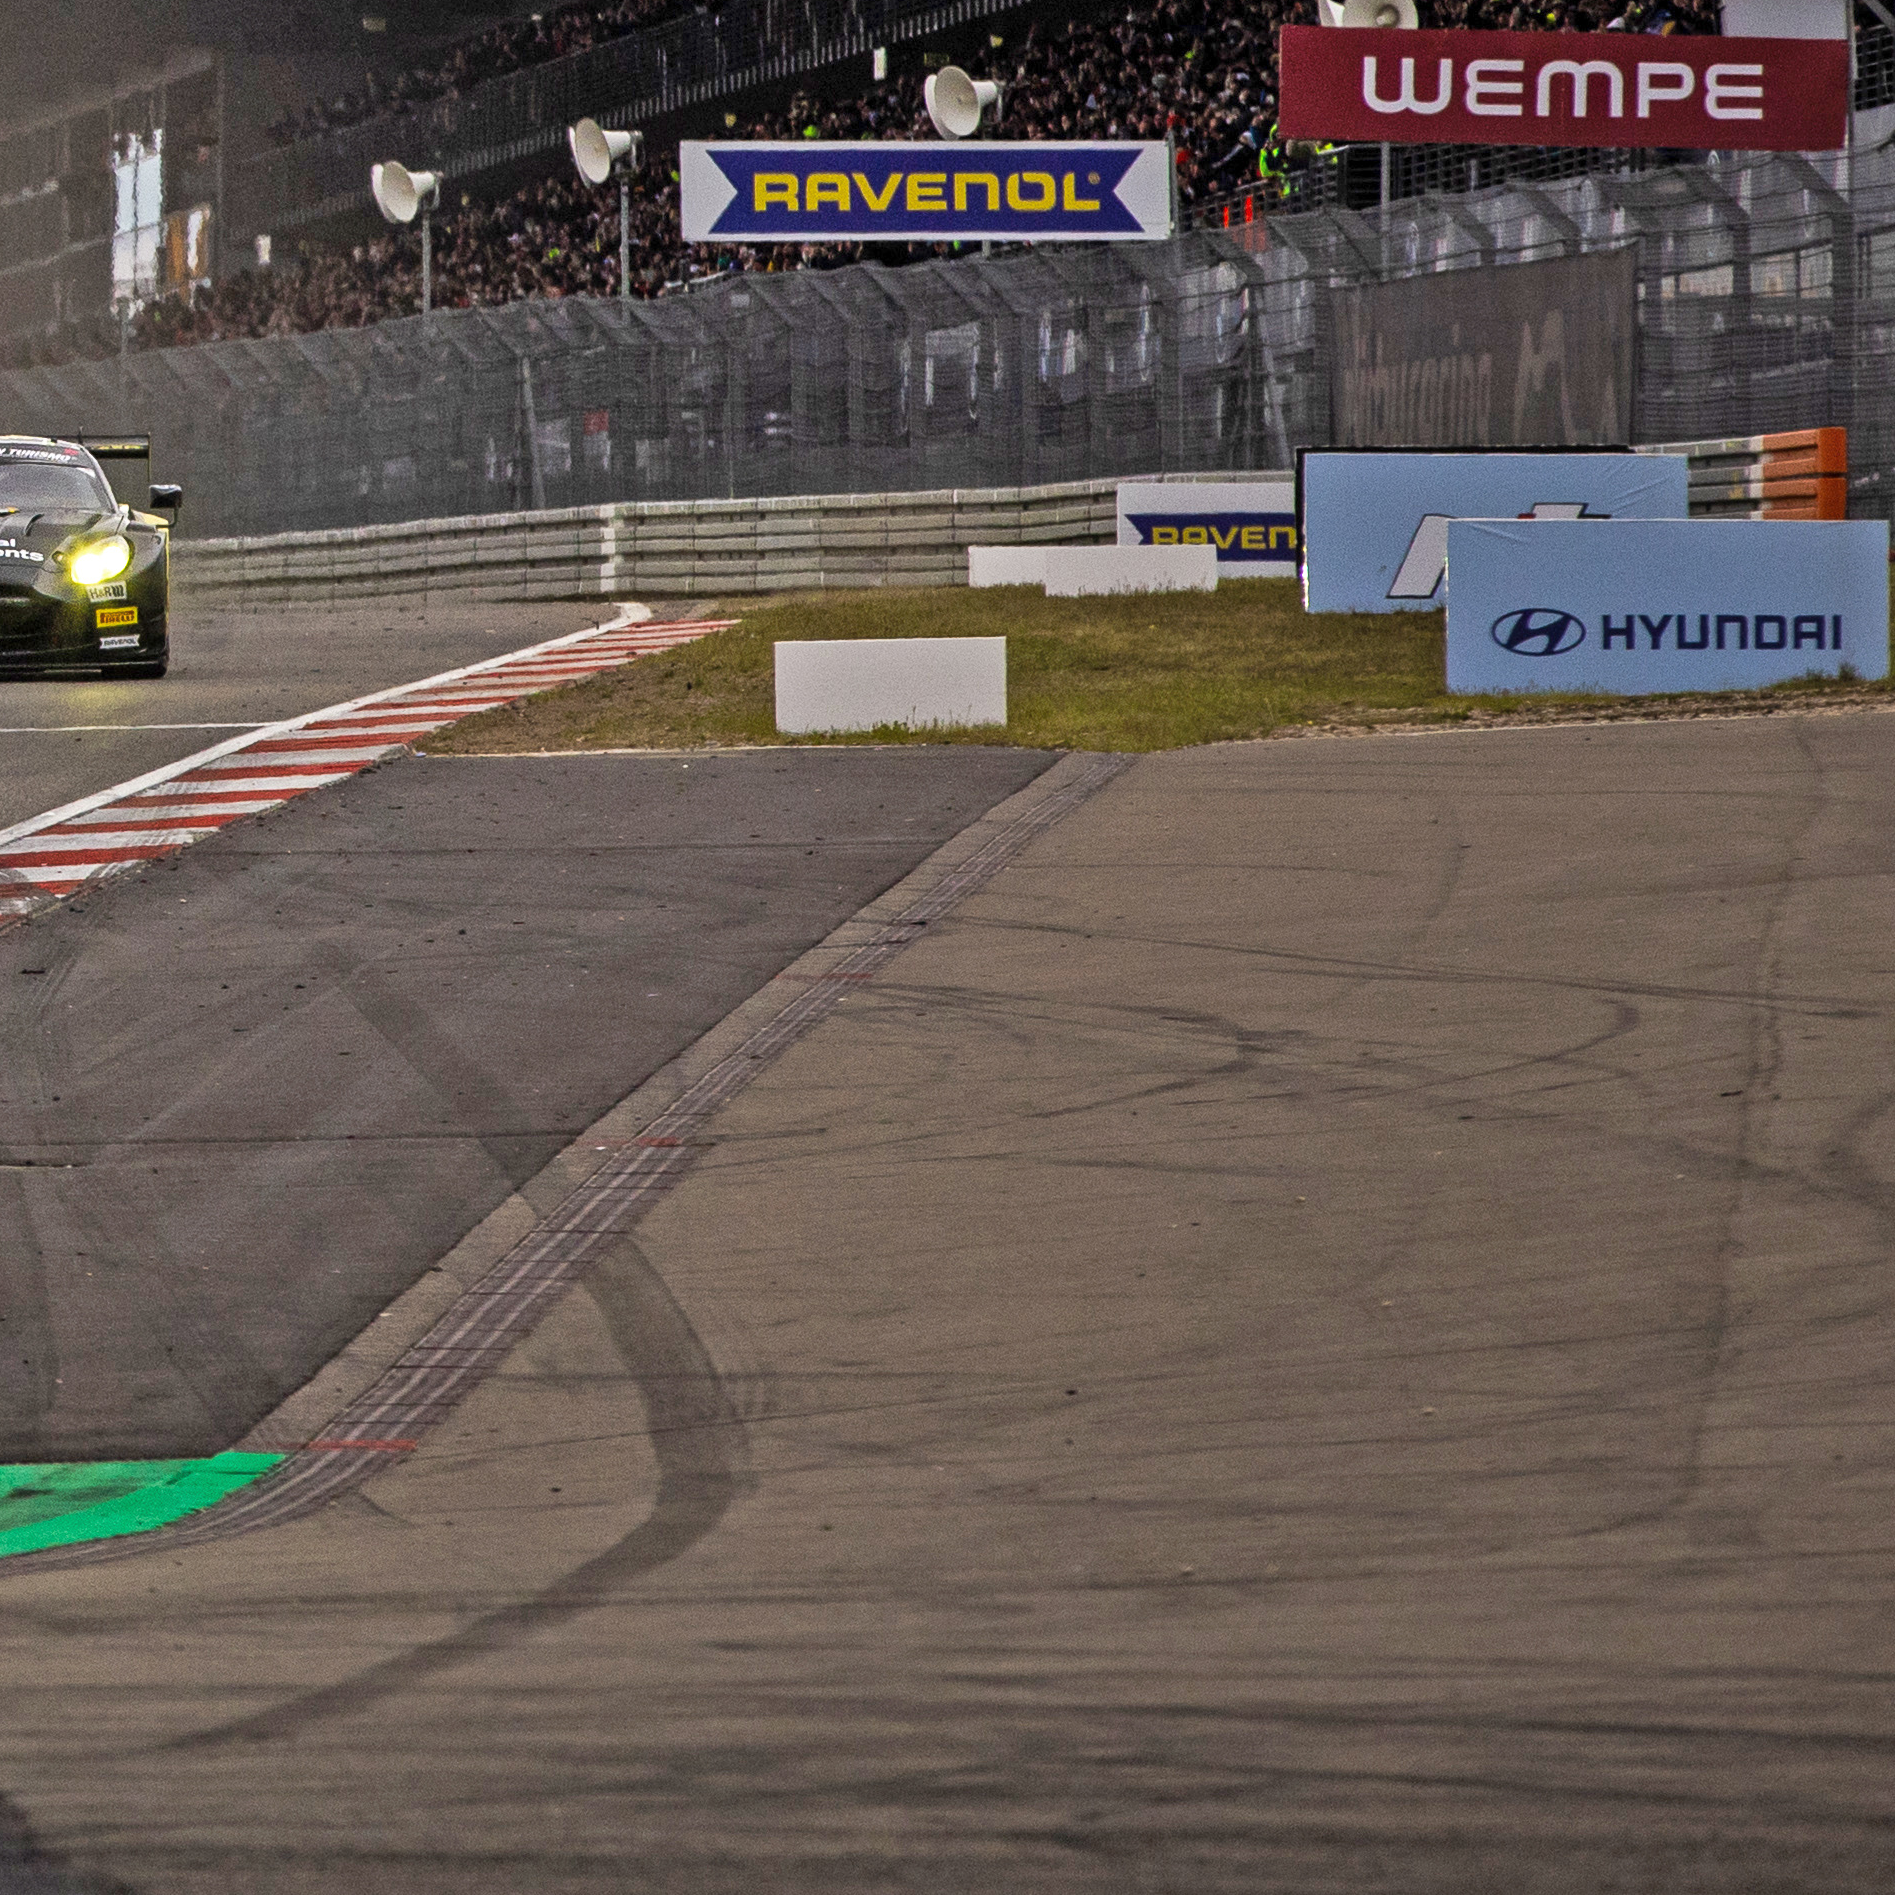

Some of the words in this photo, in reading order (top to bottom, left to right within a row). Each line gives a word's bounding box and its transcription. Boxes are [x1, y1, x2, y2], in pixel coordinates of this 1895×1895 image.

[1364, 56, 1764, 120] WEMPE
[752, 171, 1101, 212] RAVENOL
[10, 449, 70, 462] TURISMO
[1601, 614, 1843, 651] HYUNDAI
